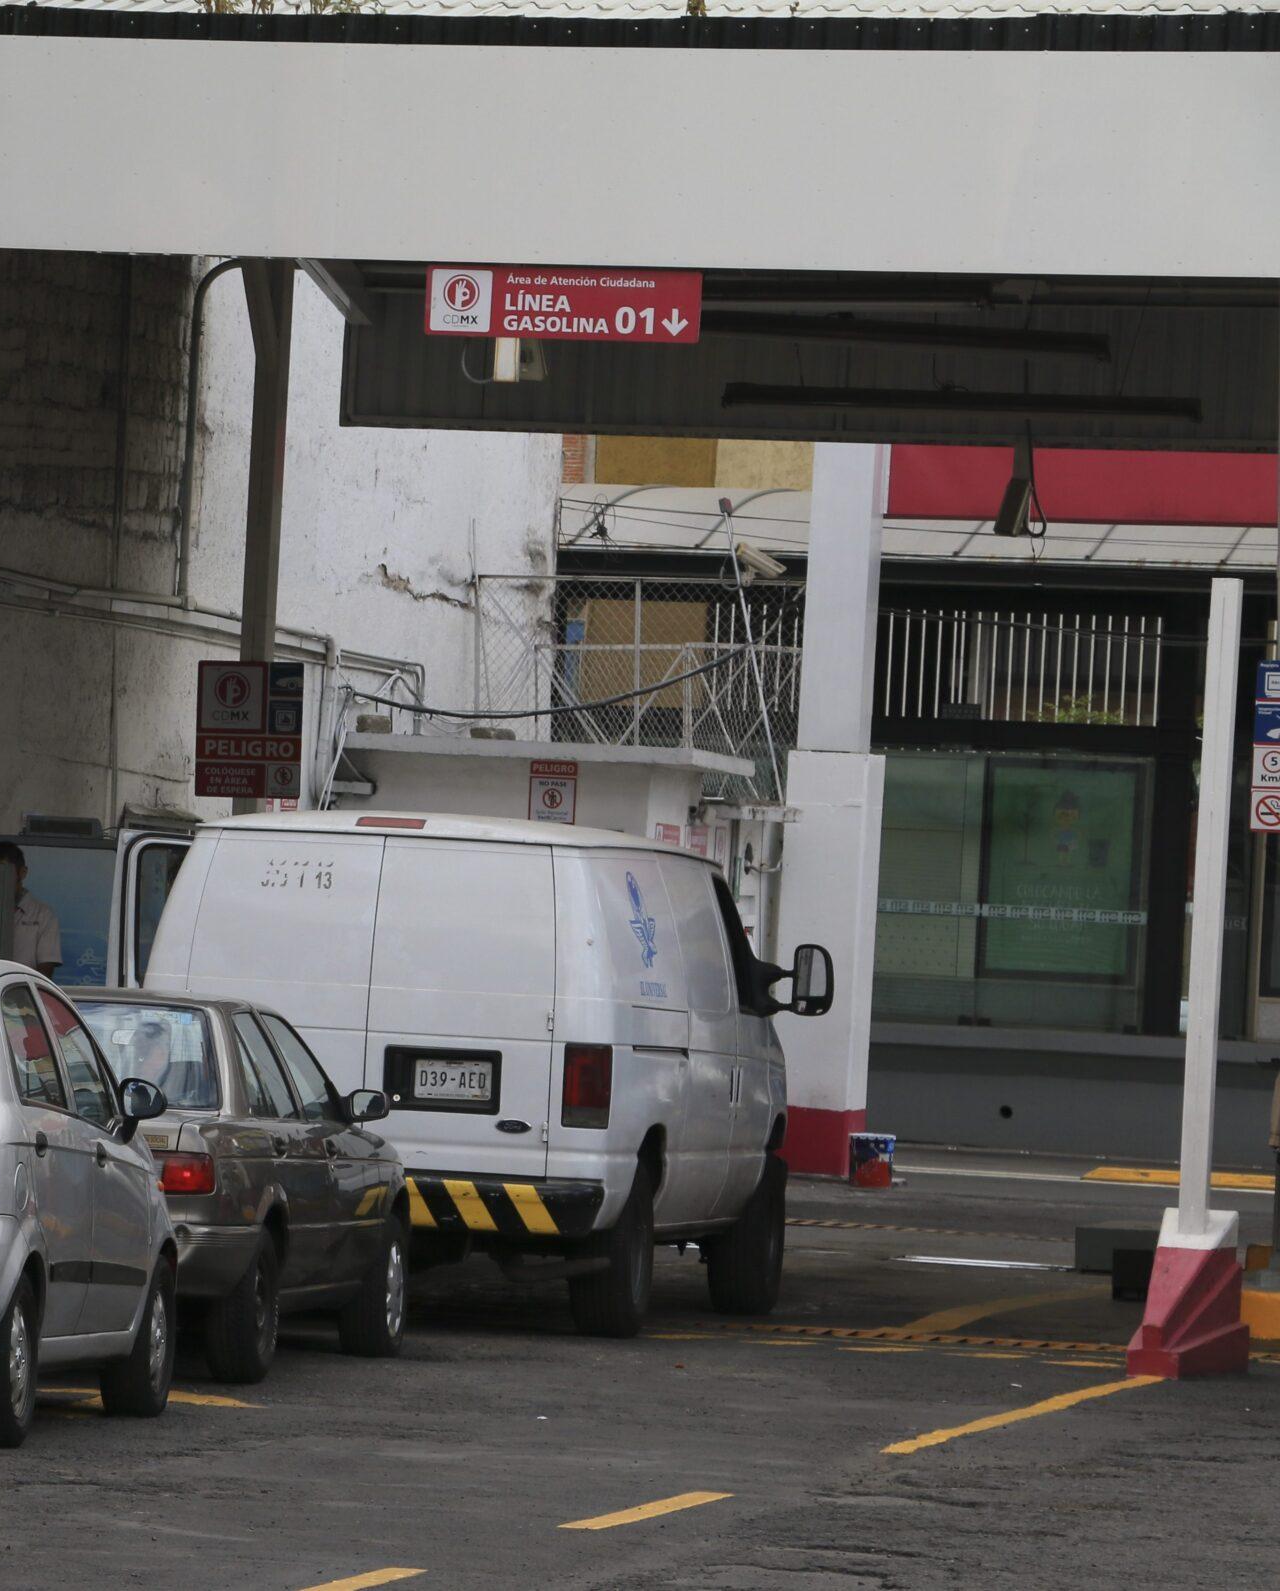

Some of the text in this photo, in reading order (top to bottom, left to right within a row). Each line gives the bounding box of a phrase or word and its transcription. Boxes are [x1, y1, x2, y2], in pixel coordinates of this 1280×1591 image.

[506, 272, 656, 289] Área de Atención Ciudadana
[504, 290, 571, 312] LÍNEA
[442, 313, 478, 325] CDMX
[503, 306, 656, 335] GASOLINA 01
[211, 709, 250, 721] CDMX
[204, 739, 294, 758] PELIGRO
[532, 762, 576, 775] PELIGRO
[1270, 756, 1278, 767] 5
[420, 1070, 487, 1090] D39-AED
